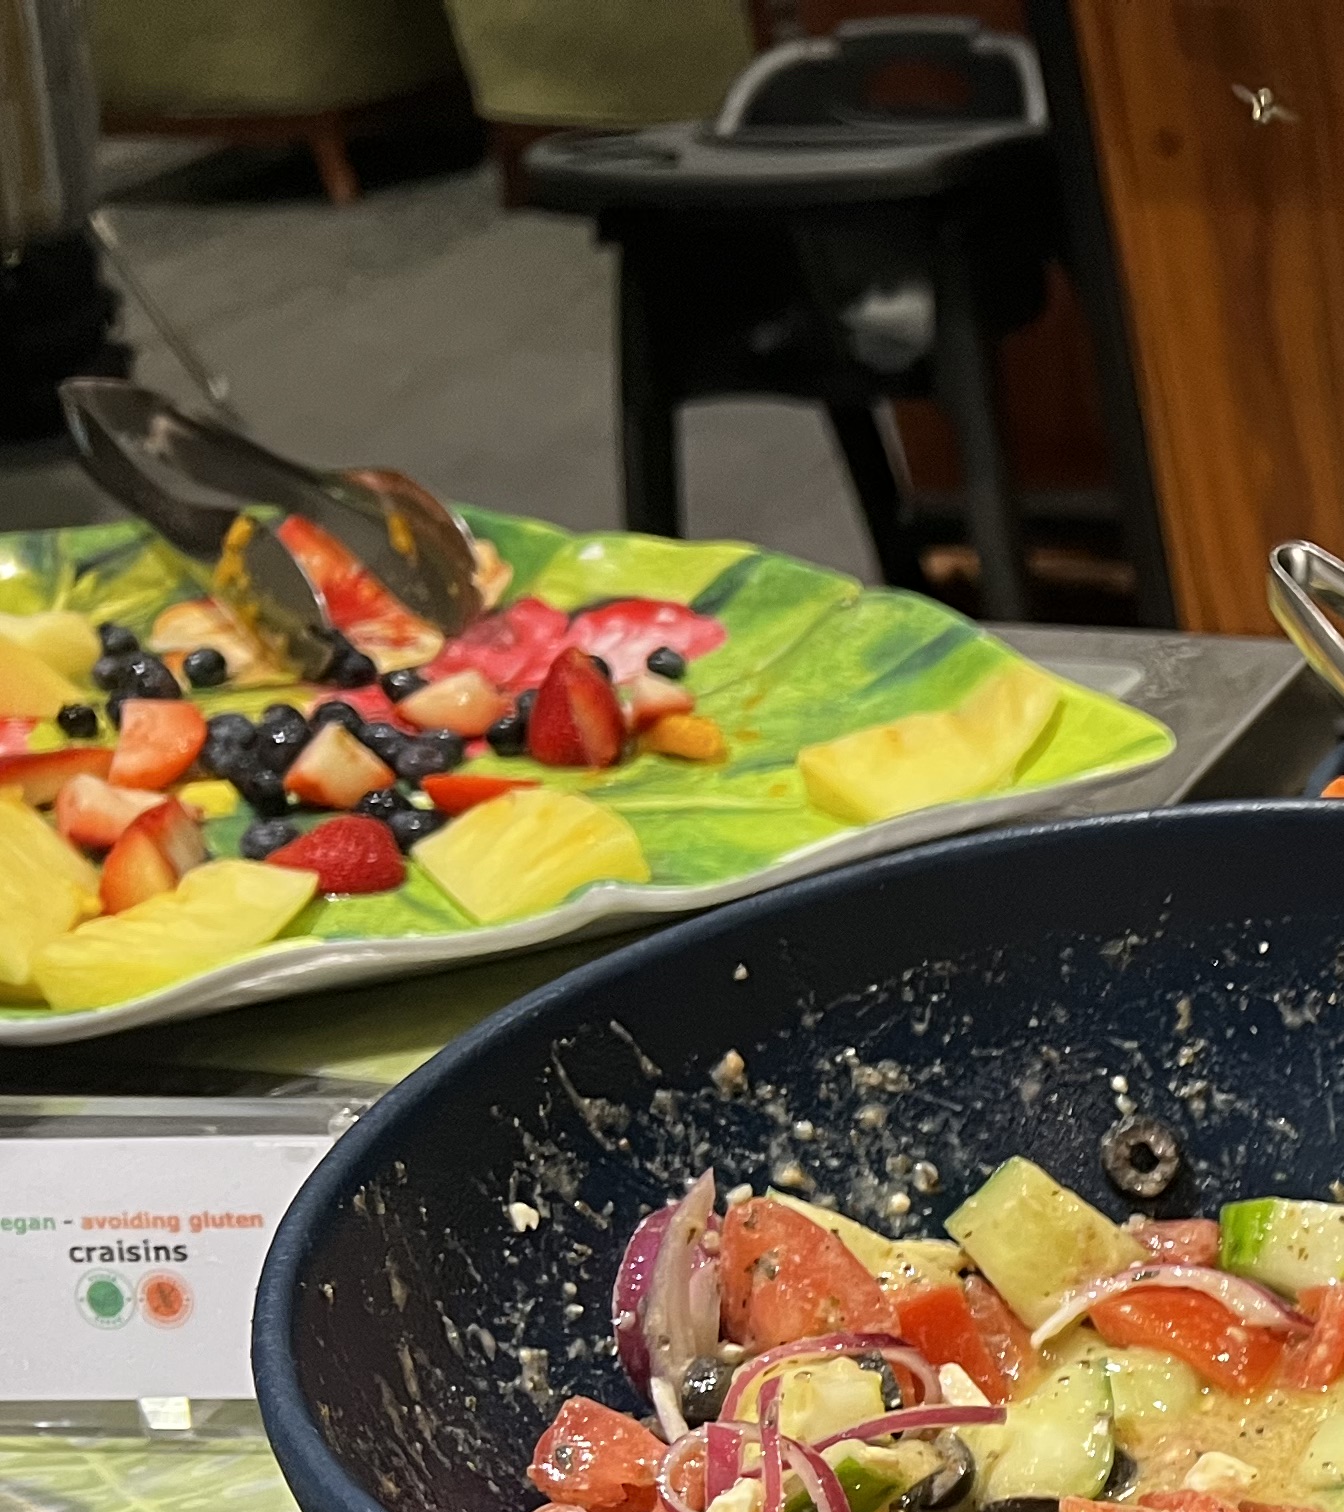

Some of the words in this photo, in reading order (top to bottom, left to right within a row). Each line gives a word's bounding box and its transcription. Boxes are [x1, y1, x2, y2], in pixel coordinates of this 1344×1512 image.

[0, 1216, 57, 1236] egan
[81, 1211, 181, 1233] avoiding
[189, 1211, 265, 1233] gluten
[69, 1239, 189, 1263] craisins
